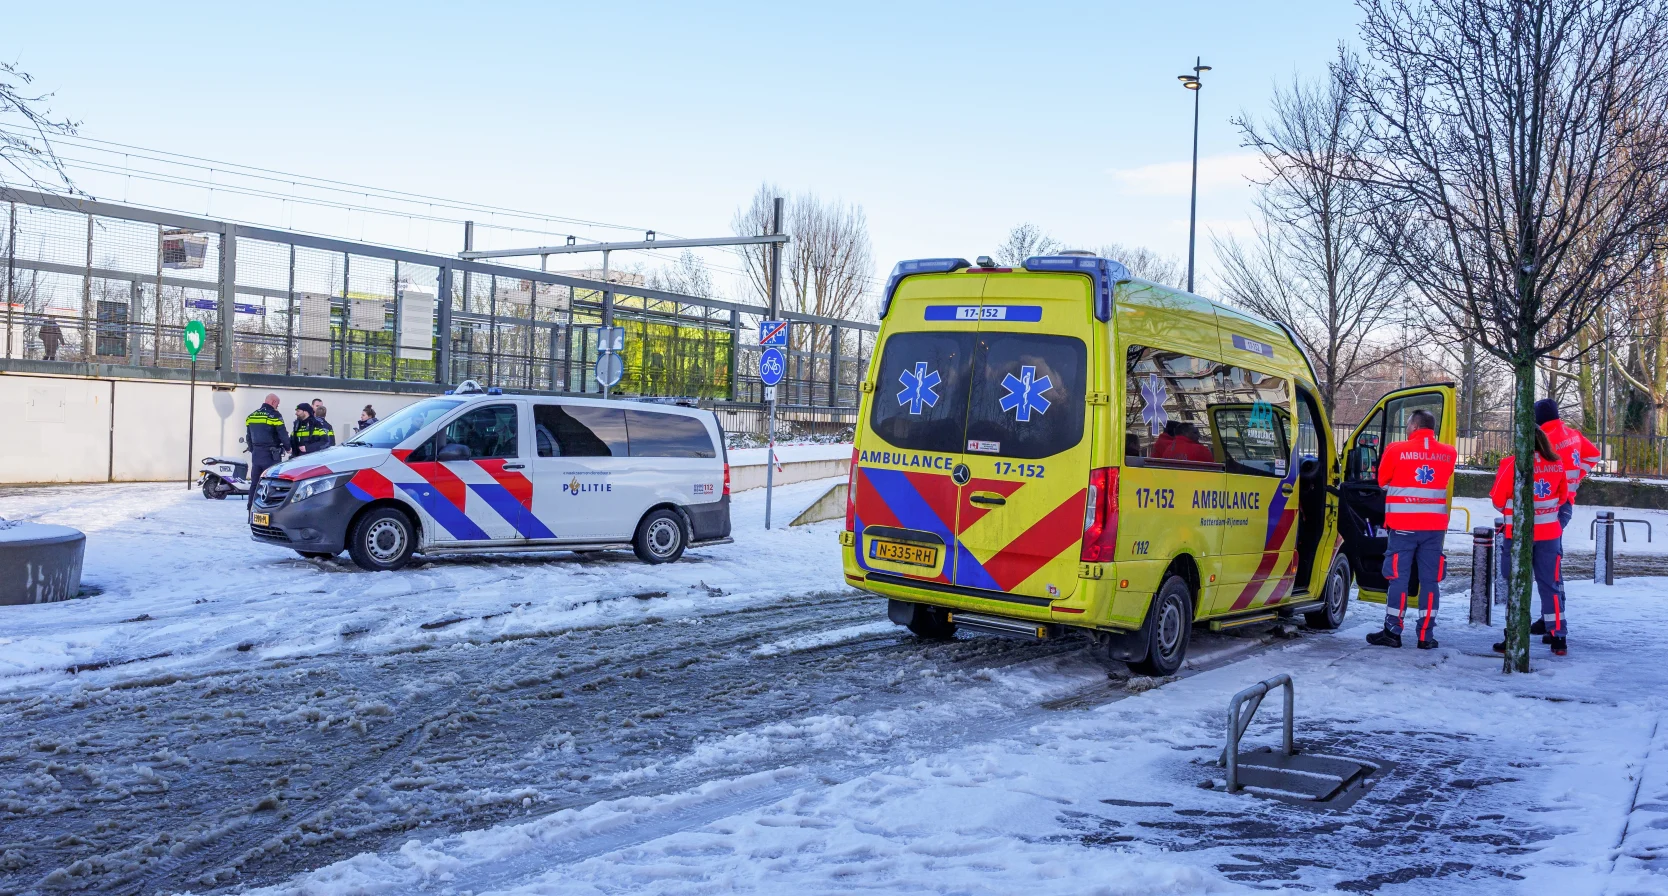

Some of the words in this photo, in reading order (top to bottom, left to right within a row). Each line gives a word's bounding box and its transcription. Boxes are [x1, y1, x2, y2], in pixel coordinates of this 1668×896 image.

[964, 308, 998, 318] 17-152
[860, 450, 953, 471] AMBULANCE
[1400, 451, 1451, 463] AMBULANCE
[994, 461, 1045, 479] 17-152
[1533, 464, 1563, 474] ULANCE
[563, 483, 612, 496] POLITIE
[1136, 488, 1175, 509] 17-152
[1192, 489, 1260, 509] AMBULANCE
[1200, 517, 1249, 528] Rotterdam-Rijnmond
[879, 544, 932, 563] N-335-RH
